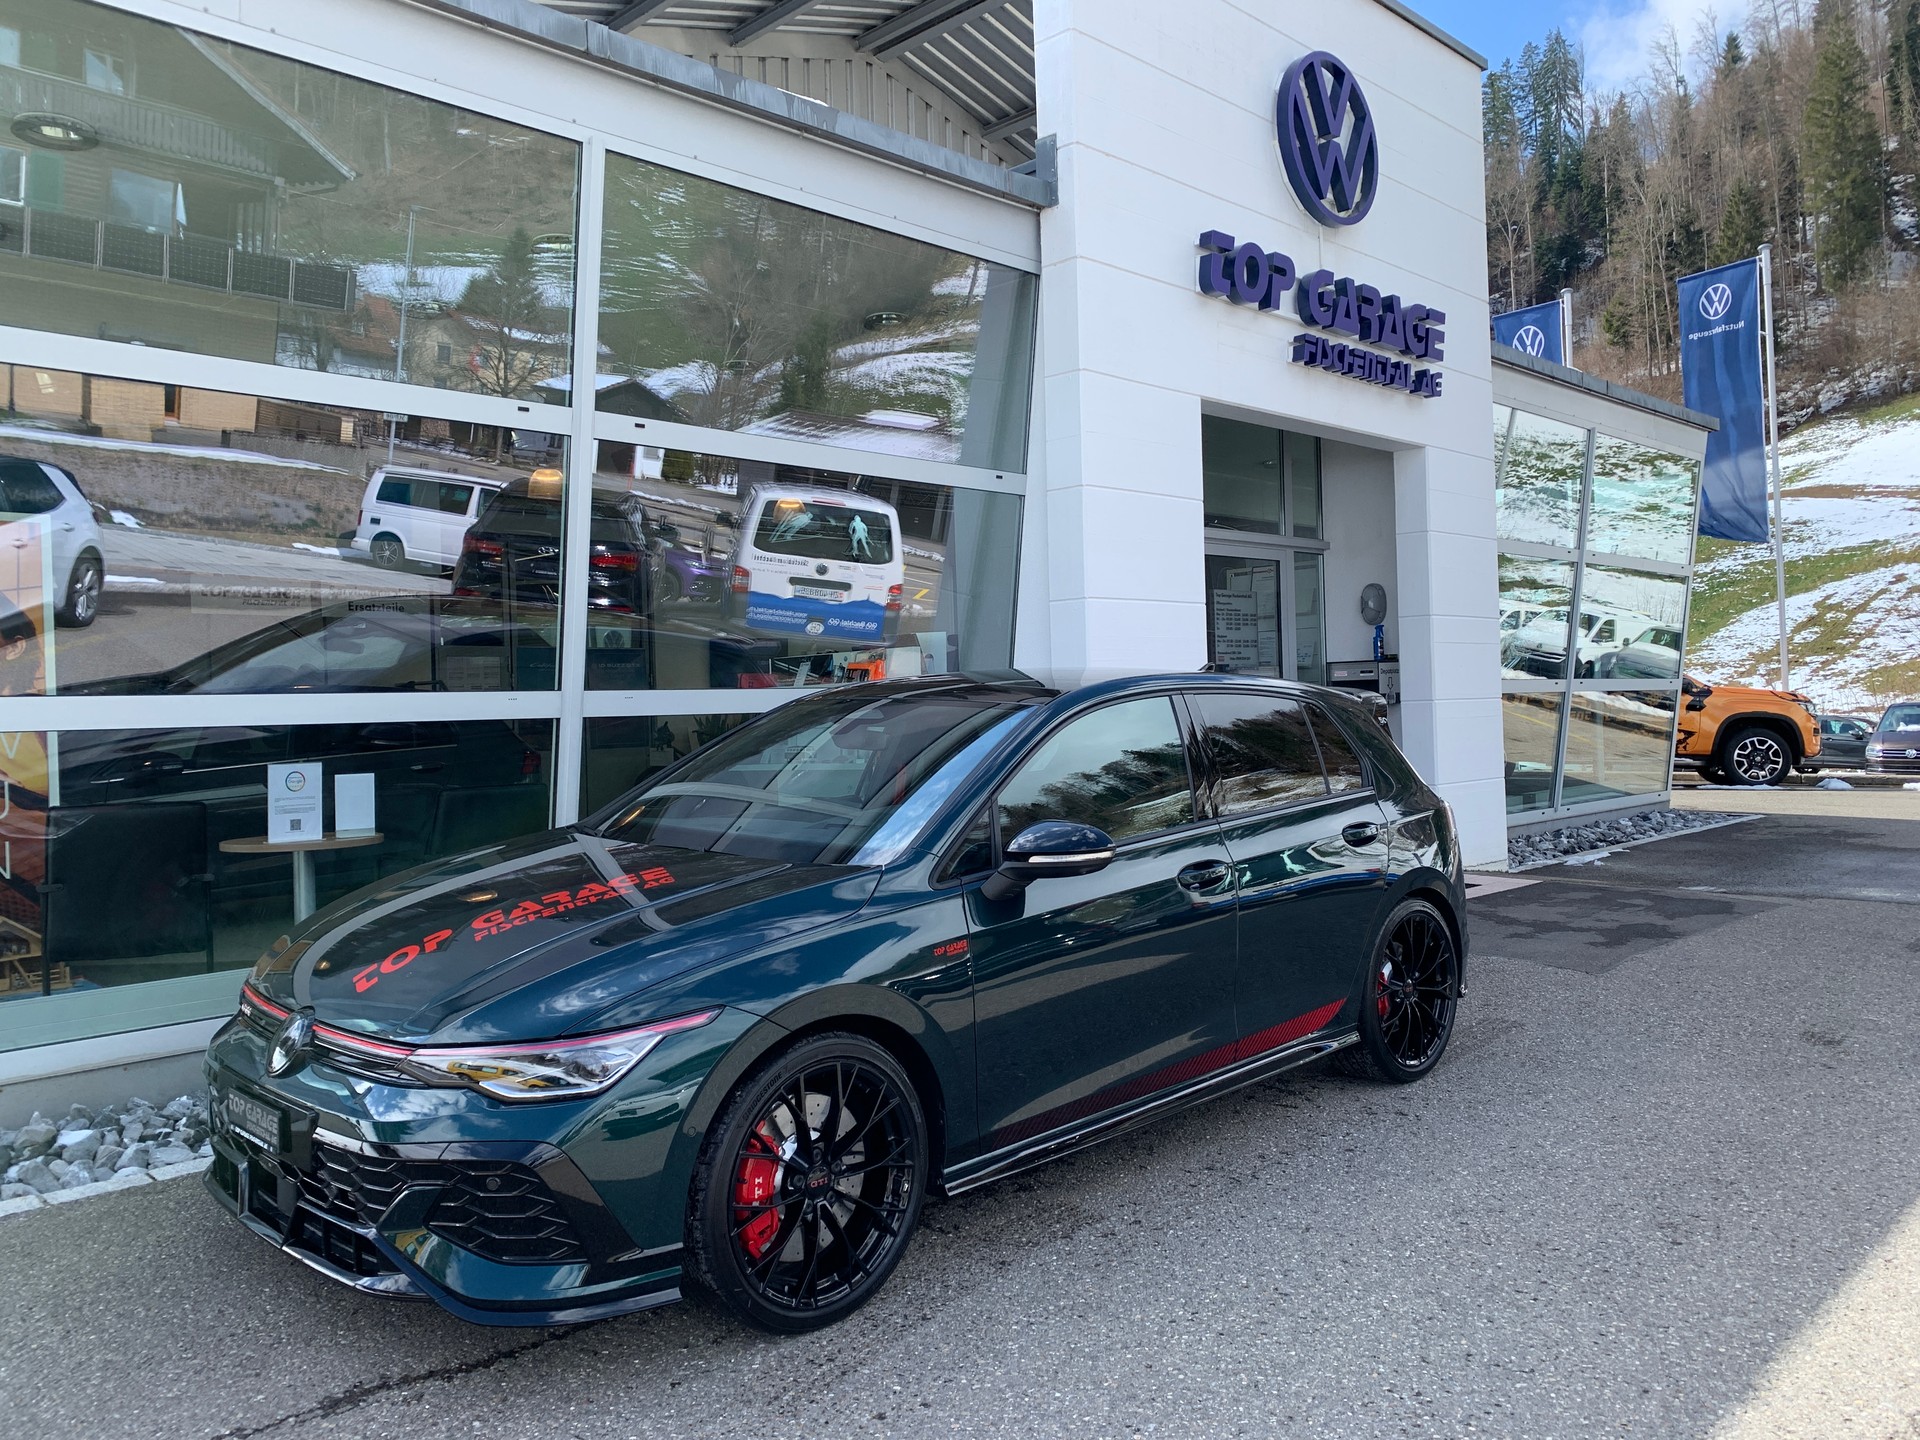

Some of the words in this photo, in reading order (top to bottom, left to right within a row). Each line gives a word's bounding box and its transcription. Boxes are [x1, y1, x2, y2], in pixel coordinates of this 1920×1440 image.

[1199, 230, 1295, 311] TOP
[1297, 269, 1446, 363] GARAGE
[1292, 333, 1414, 391] FISCHENTHAL
[1409, 368, 1443, 398] AG
[348, 601, 405, 613] Ersatzteile
[353, 929, 453, 993] TOP
[471, 867, 672, 929] GARAGE
[474, 883, 633, 942] FISCHENTHAL
[643, 876, 675, 891] AG
[933, 946, 945, 956] TOP
[945, 939, 967, 952] GARAGE
[229, 1093, 245, 1115] TOP
[245, 1103, 278, 1134] GARAGE
[744, 1072, 783, 1120] BRIDGESTONE
[810, 1178, 828, 1189] GTI
